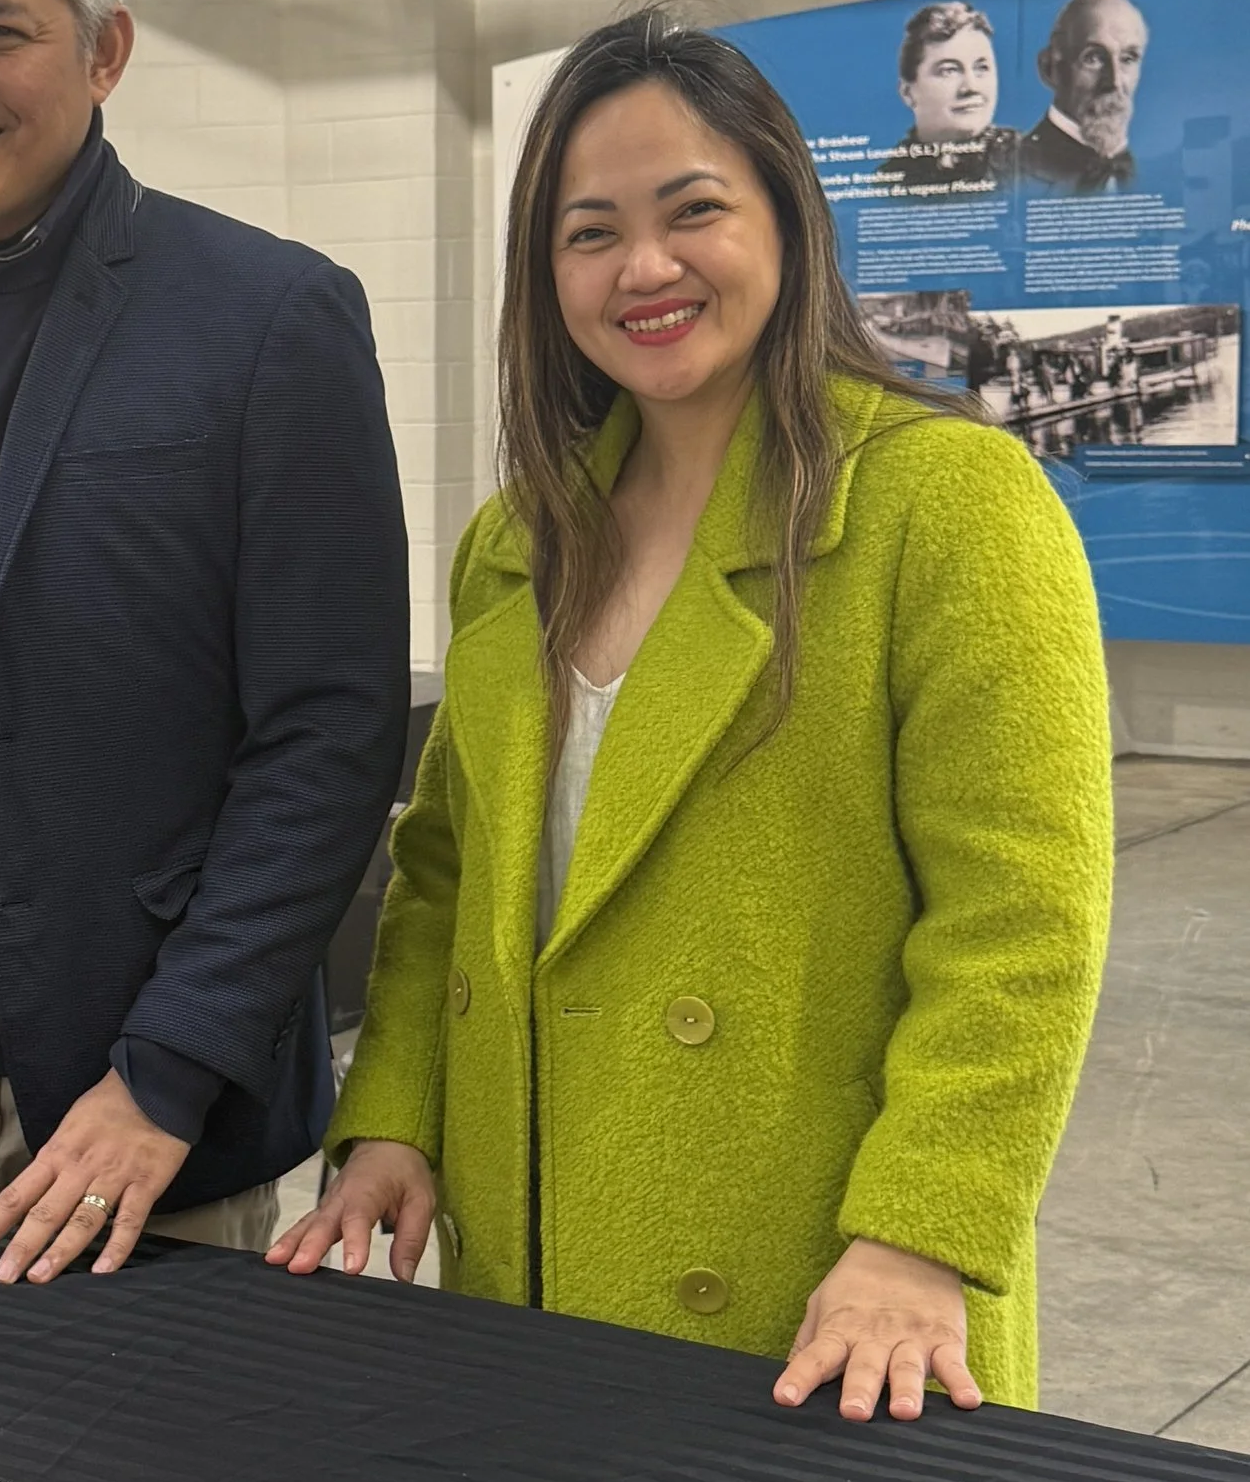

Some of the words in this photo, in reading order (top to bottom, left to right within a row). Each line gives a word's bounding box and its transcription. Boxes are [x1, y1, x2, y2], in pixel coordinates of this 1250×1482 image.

[866, 145, 908, 159] Launch
[941, 140, 987, 155] Phoebe
[951, 179, 997, 193] Phoebe
